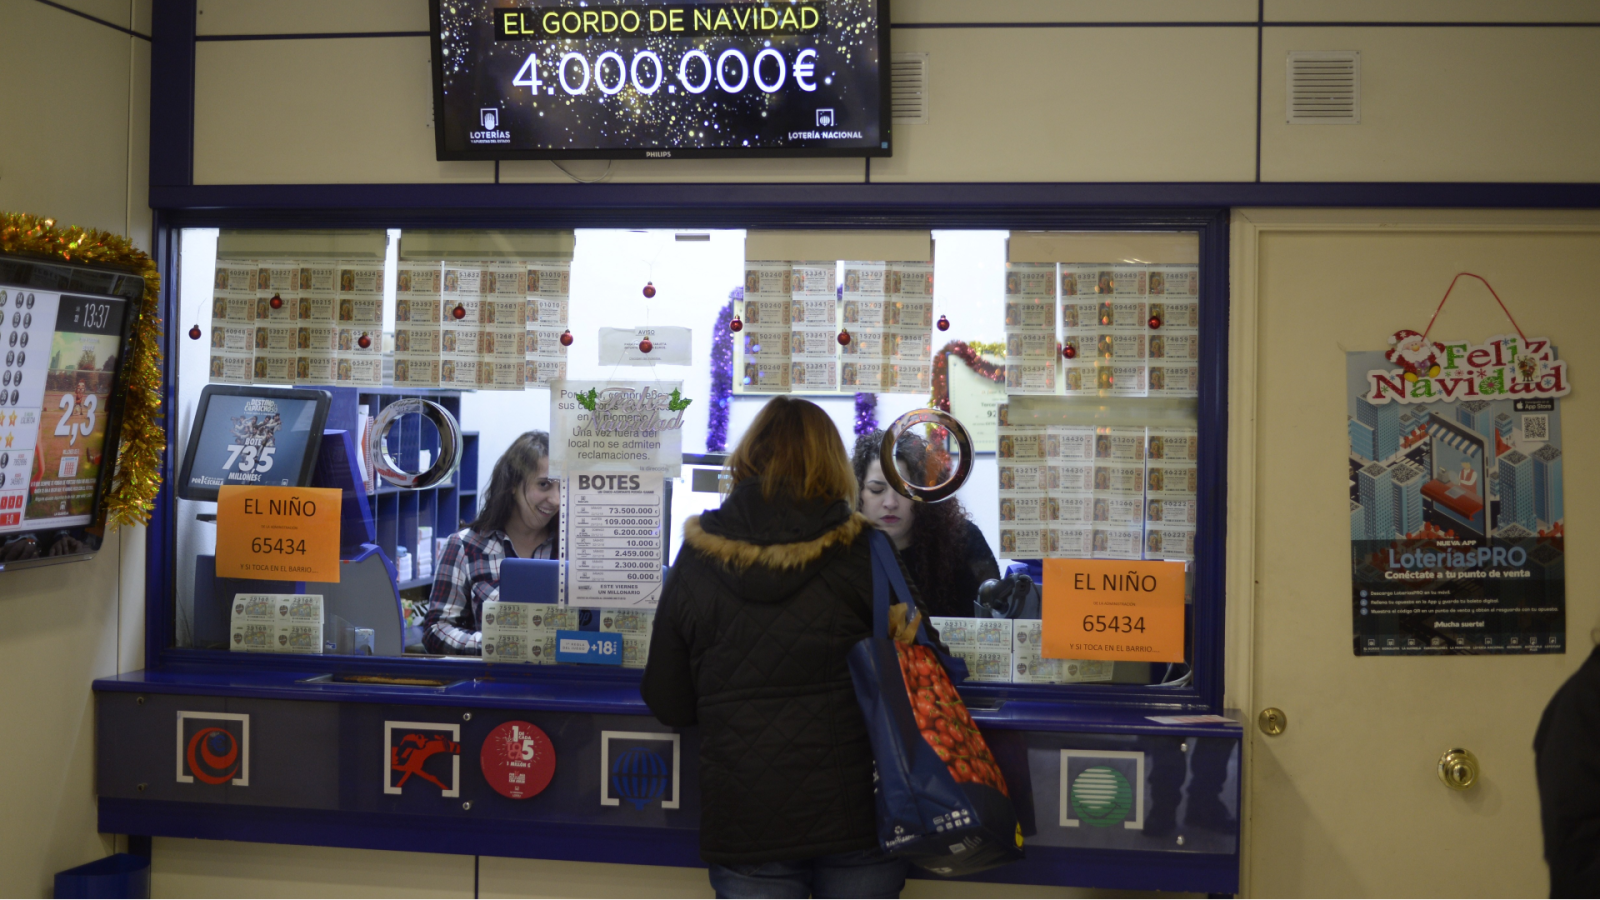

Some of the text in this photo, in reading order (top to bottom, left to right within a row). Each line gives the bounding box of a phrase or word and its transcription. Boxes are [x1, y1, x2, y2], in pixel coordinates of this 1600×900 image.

[504, 6, 820, 35] EL GORDO DE NAVIDAD
[512, 48, 817, 96] 4.000.000€
[470, 130, 510, 139] LOTERÍAS
[788, 130, 863, 140] LOTERÍA NACIONAL
[83, 303, 110, 328] 13:37
[1444, 338, 1549, 370] Feliz
[1372, 364, 1566, 399] Navidad
[54, 392, 98, 446] 2,3
[568, 439, 590, 448] local
[622, 440, 661, 449] admiten
[578, 450, 650, 460] reclamaciones.
[578, 475, 640, 490] BOTES
[245, 496, 316, 517] EL NIÑO
[252, 537, 307, 555] 65434
[1388, 546, 1527, 568] LoteríasPRO
[1074, 570, 1157, 592] EL NIÑO
[1385, 570, 1435, 580] Conéctate
[1446, 570, 1456, 579] tu
[1458, 570, 1487, 579] punto
[1489, 569, 1501, 578] de
[1503, 570, 1531, 578] venta
[1082, 615, 1146, 633] 65434
[591, 641, 613, 655] +18
[522, 740, 534, 760] 5
